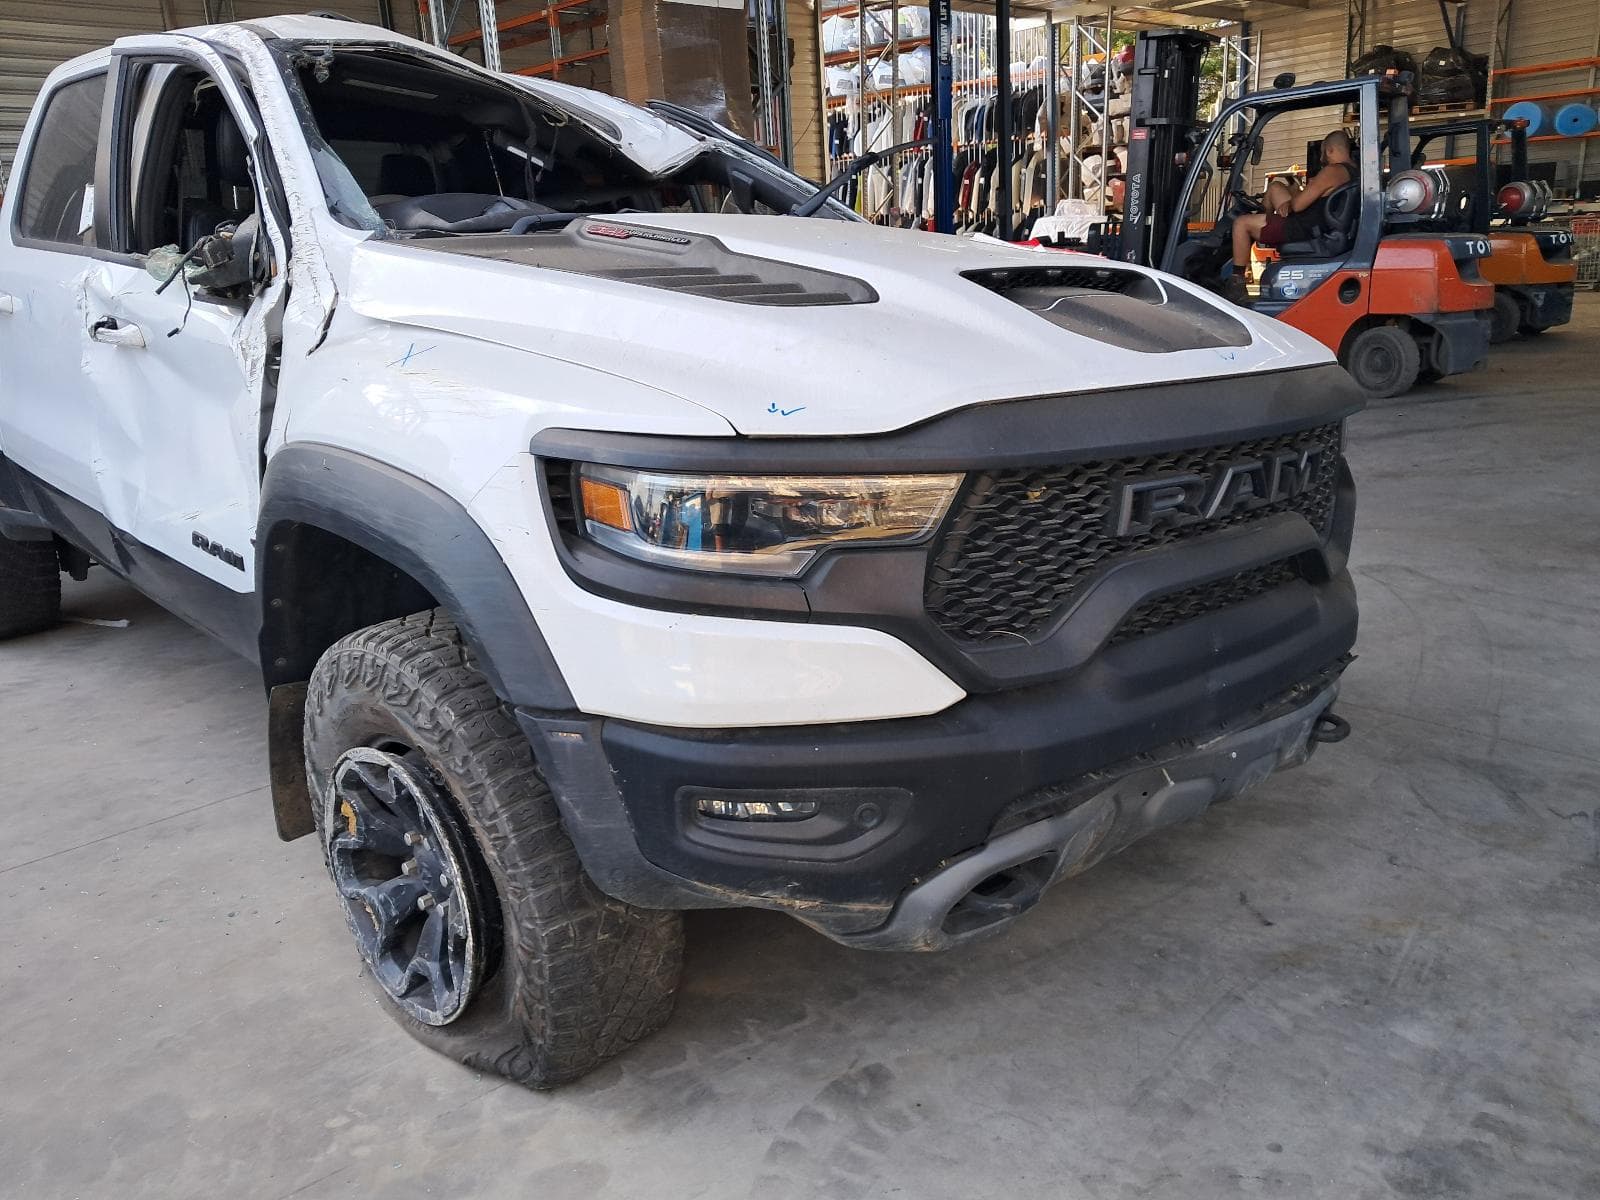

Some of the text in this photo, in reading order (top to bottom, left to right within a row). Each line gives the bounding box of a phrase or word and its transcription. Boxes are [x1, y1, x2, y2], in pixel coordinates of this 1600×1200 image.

[940, 23, 948, 60] ROTARY
[1130, 173, 1141, 224] TOYOTA
[1279, 270, 1304, 280] 25
[1117, 450, 1321, 536] RAM
[191, 530, 245, 572] RAM
